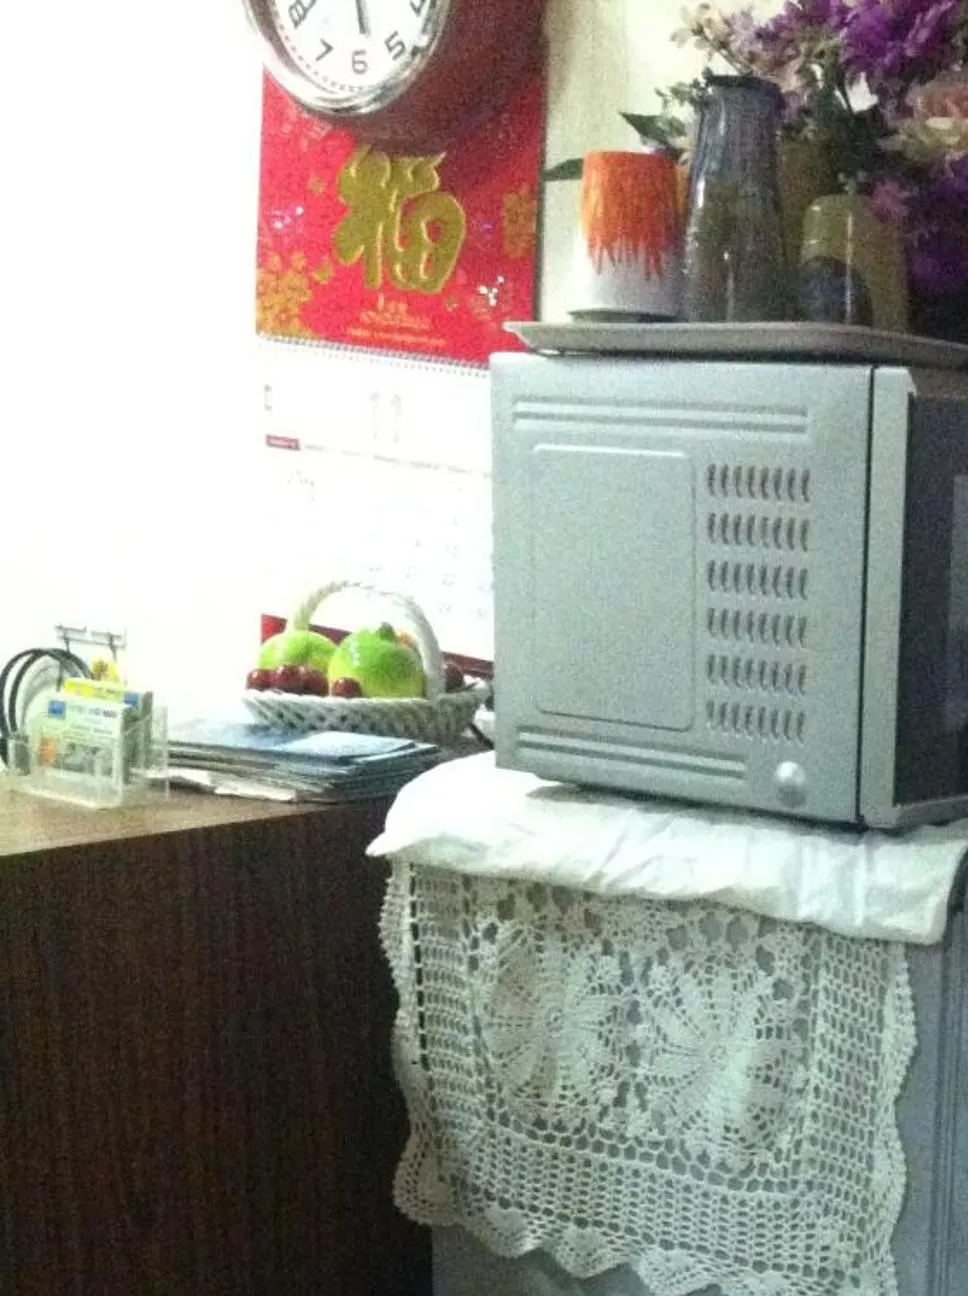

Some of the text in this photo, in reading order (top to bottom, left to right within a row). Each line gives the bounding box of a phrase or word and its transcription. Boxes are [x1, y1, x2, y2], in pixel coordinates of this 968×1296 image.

[315, 39, 334, 62] 7
[384, 31, 406, 61] 5
[351, 49, 368, 75] 6
[336, 145, 466, 293] 福
